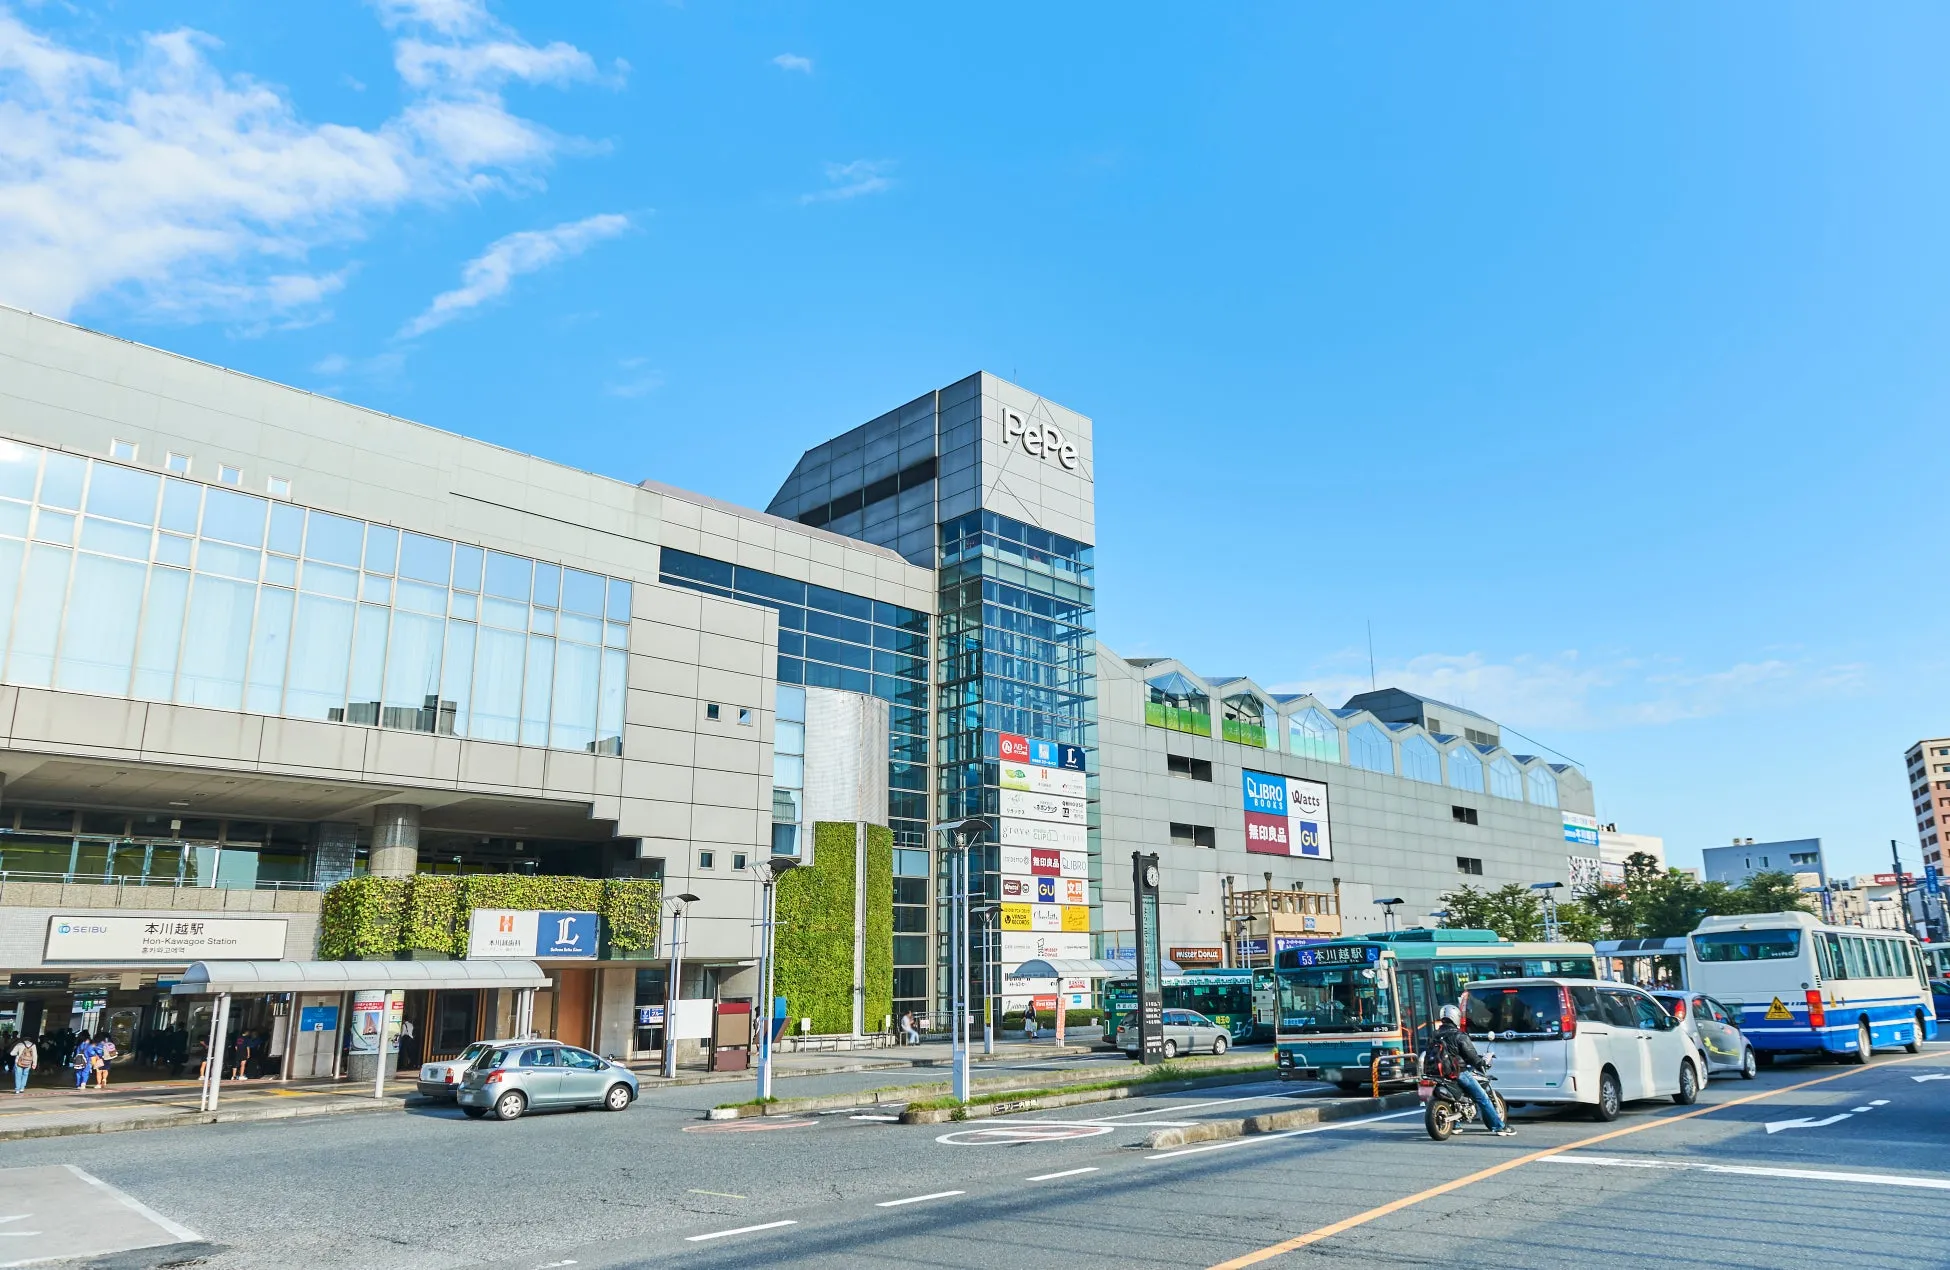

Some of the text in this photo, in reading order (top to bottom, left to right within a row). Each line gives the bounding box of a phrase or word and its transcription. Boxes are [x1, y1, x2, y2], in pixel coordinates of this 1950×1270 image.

[1250, 781, 1283, 802] LIBRO
[1254, 798, 1283, 810] BOOKS
[1292, 790, 1320, 806] Watts
[1248, 823, 1287, 844] 無印良品
[1301, 830, 1319, 847] GU
[1032, 856, 1060, 868] 無印良品
[1039, 884, 1055, 896] GU
[72, 926, 107, 934] SEIBU
[144, 922, 204, 935] 本川越駅
[142, 938, 205, 946] Hon-Kawagoe
[1198, 950, 1218, 958] Donut
[1314, 948, 1363, 961] 本川越駅
[1302, 956, 1313, 966] 53
